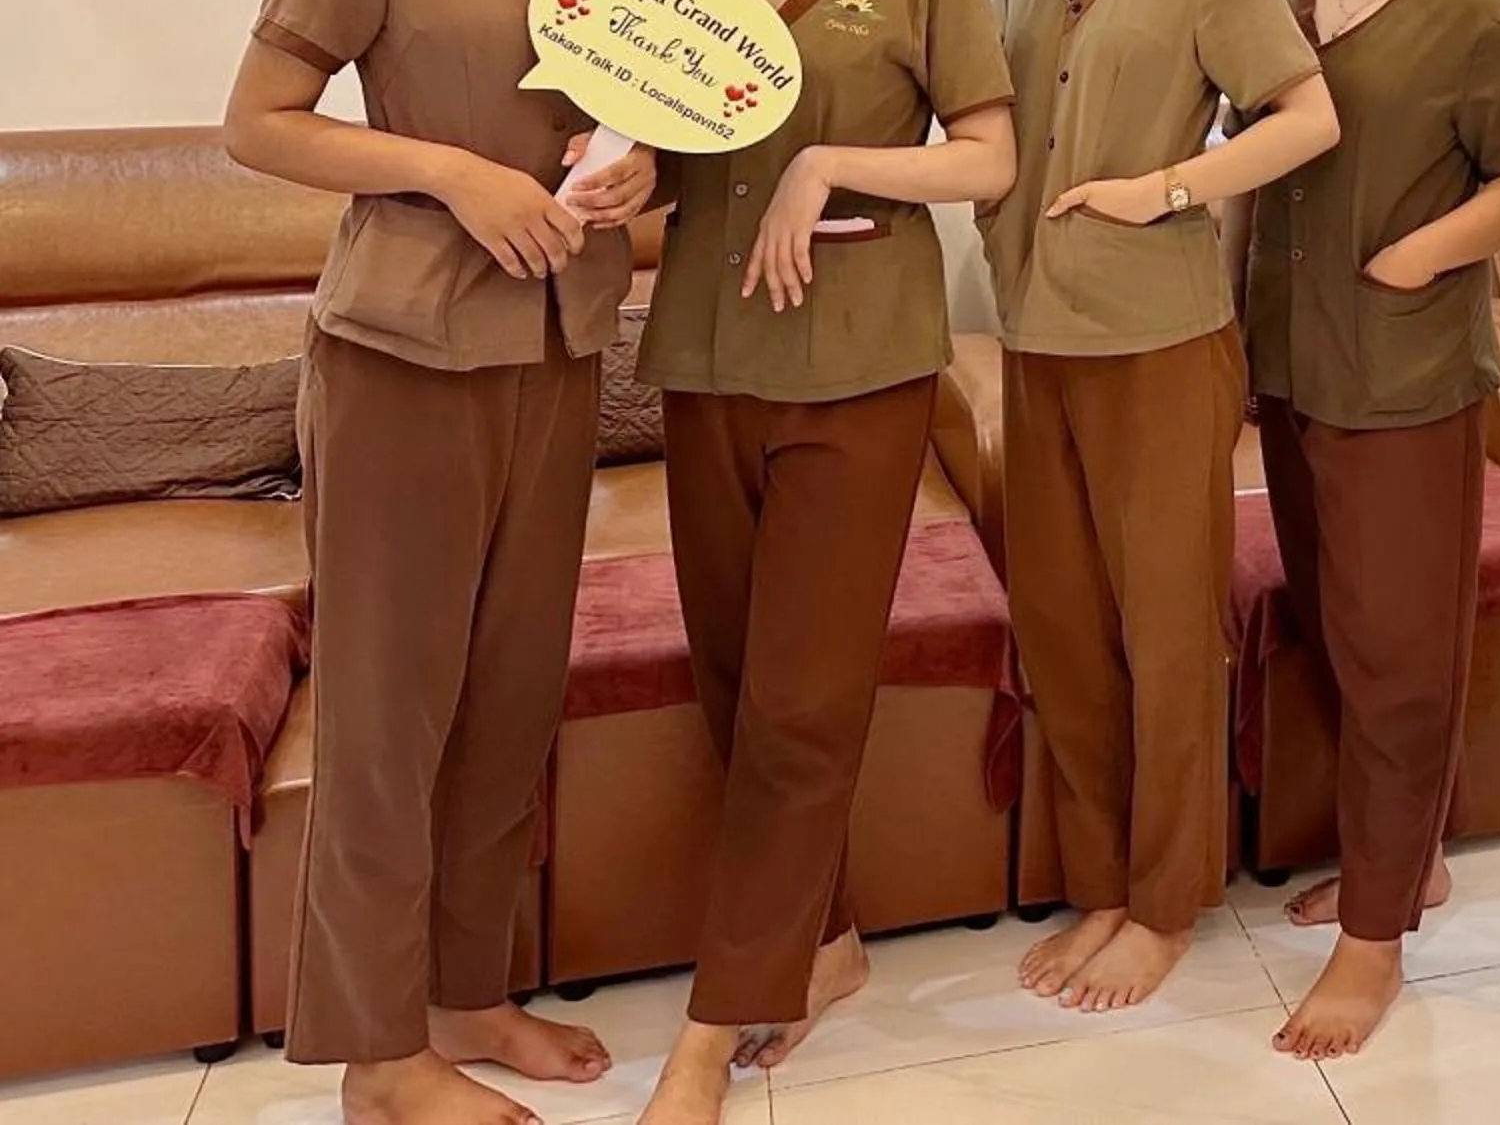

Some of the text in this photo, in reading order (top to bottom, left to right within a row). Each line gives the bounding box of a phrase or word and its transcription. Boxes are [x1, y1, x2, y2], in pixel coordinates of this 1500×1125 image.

[538, 24, 583, 55] Kakao
[584, 48, 614, 73] Talk
[615, 66, 633, 83] ID
[640, 81, 736, 140] Localspavn52
[609, 5, 719, 88] Thank You
[736, 35, 793, 91] World
